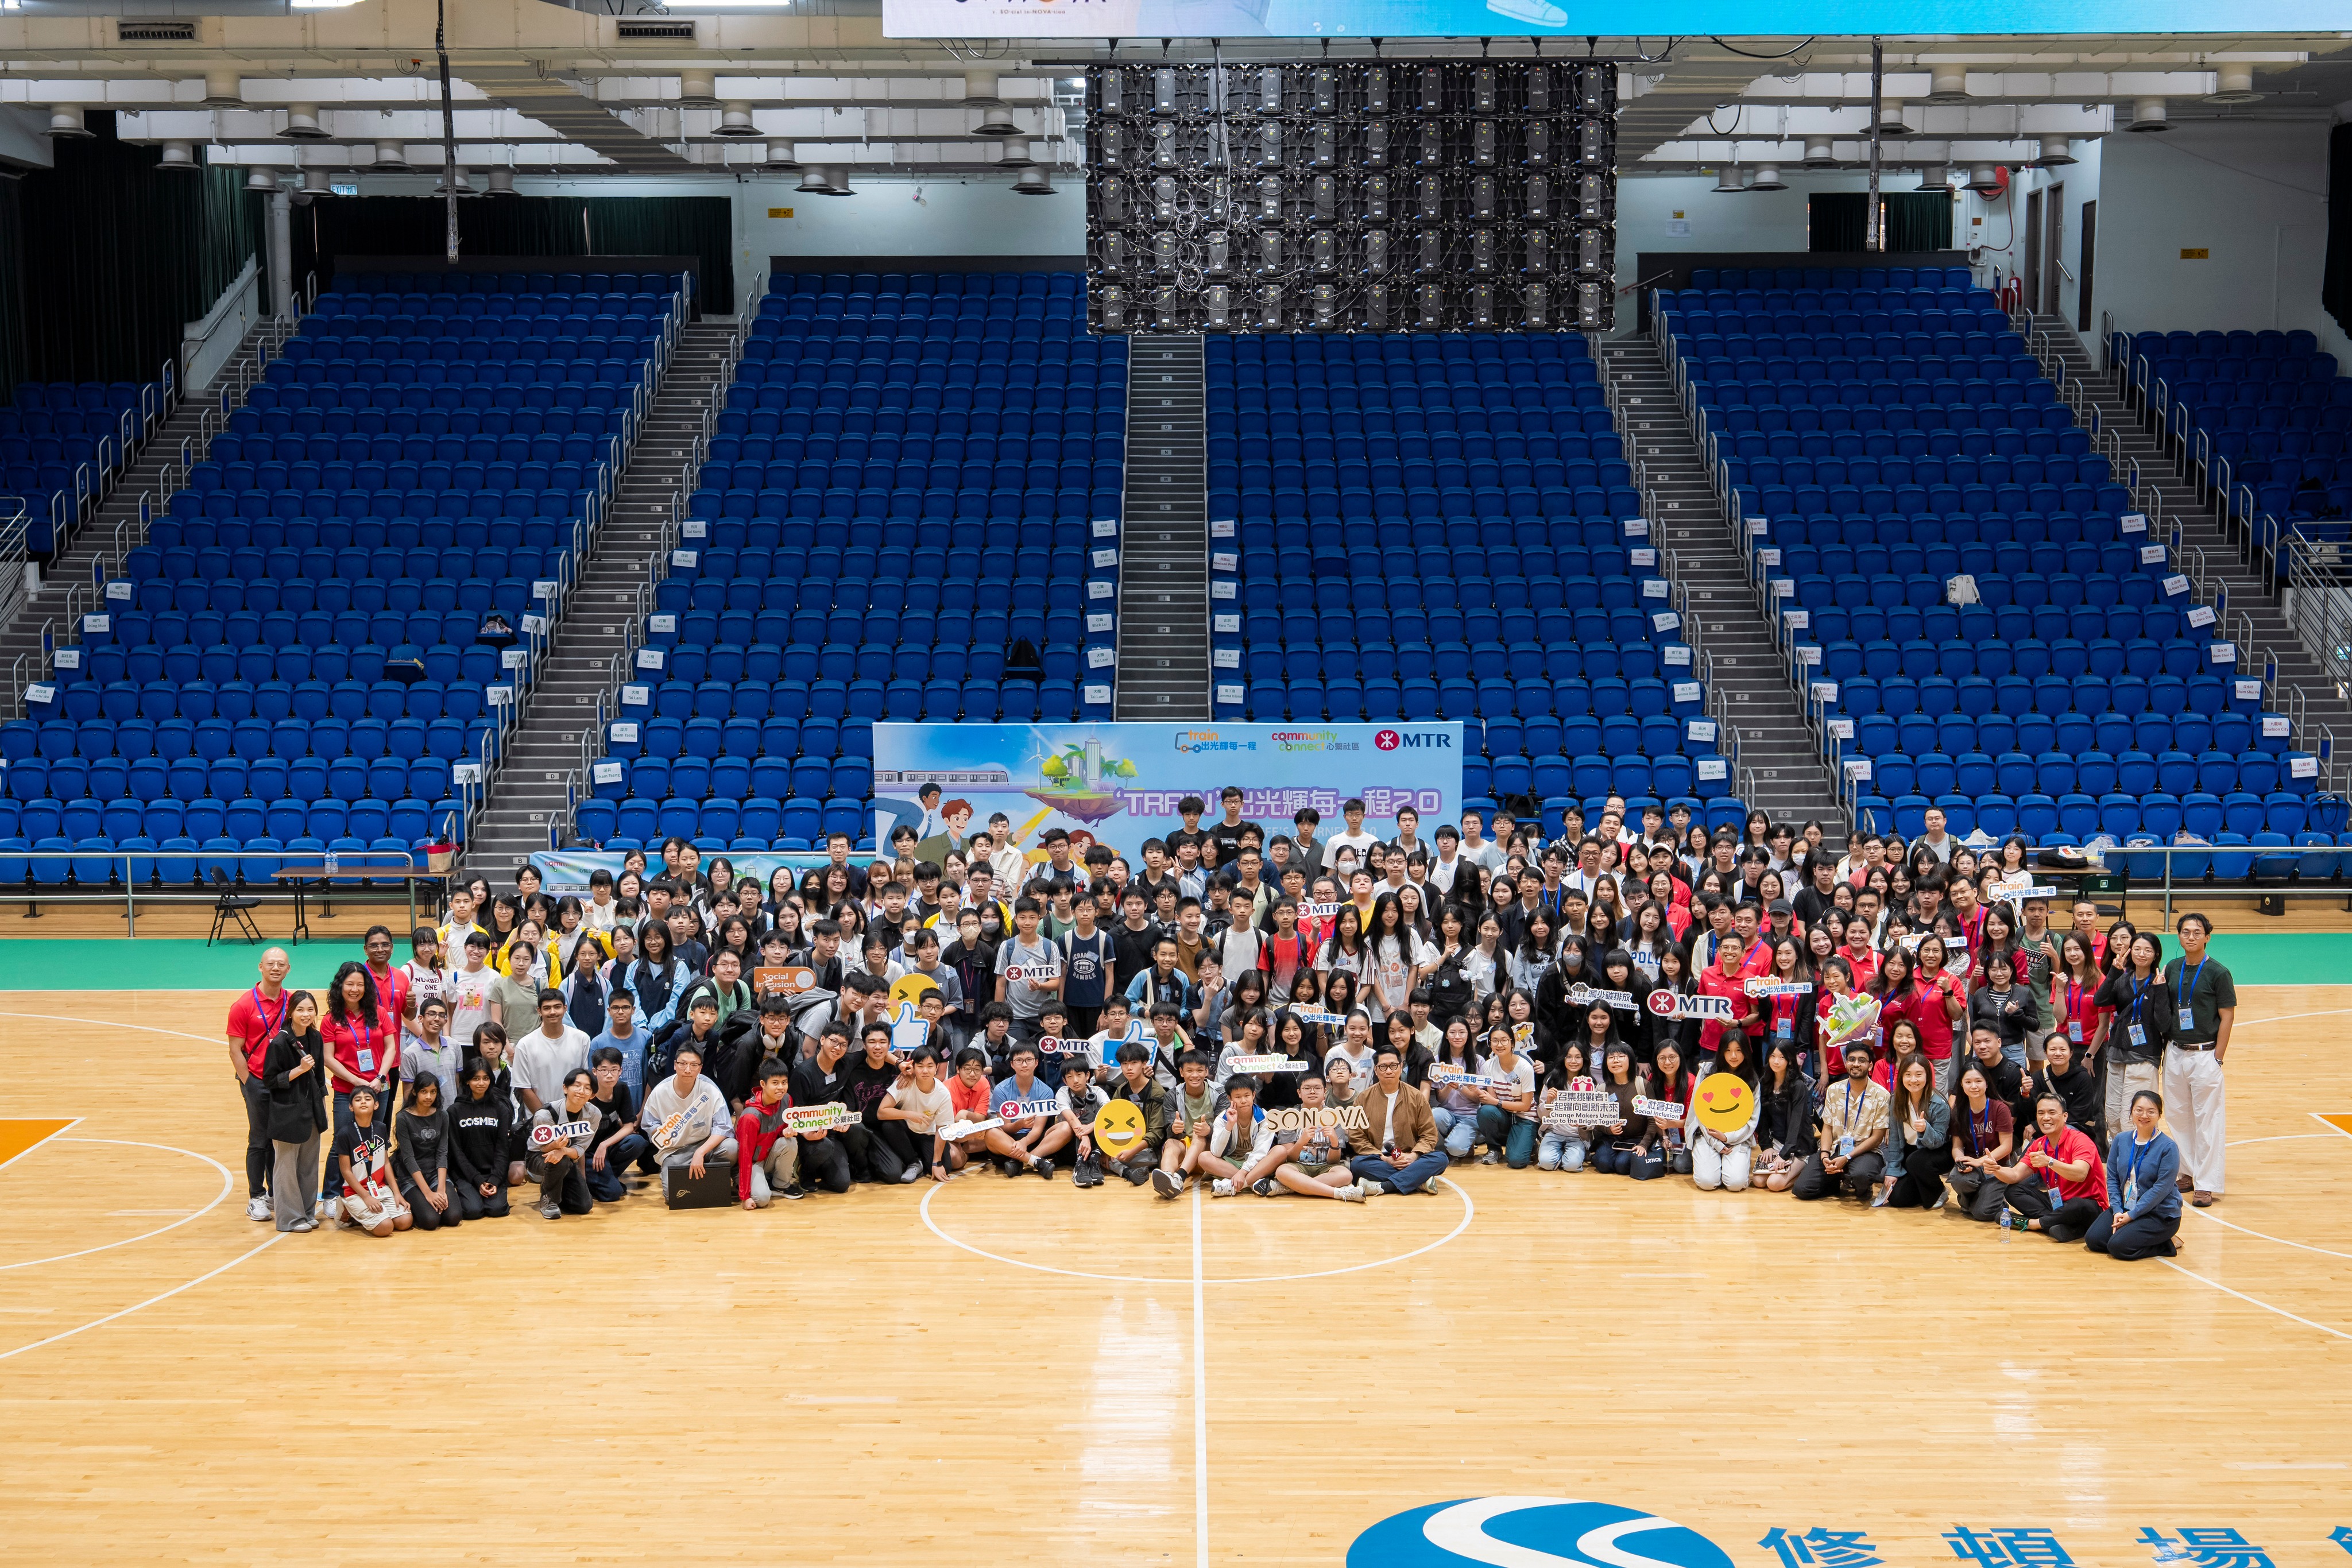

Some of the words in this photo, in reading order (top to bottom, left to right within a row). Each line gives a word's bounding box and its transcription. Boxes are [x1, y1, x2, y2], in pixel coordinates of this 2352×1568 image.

[1189, 729, 1218, 741] train
[1271, 730, 1337, 743] community
[1403, 733, 1452, 748] MTR
[1201, 741, 1257, 751] 出光輝每一程
[1279, 741, 1325, 752] connect
[1999, 882, 2024, 891] train
[2010, 888, 2054, 897] 出光輝每一程
[1312, 904, 1341, 914] MTR
[1024, 967, 1055, 977] MTR
[1756, 977, 1780, 986] train
[1766, 985, 1811, 993] 出光輝每一程
[1588, 989, 1631, 1002] 減少碳排放
[1299, 1004, 1323, 1014] train
[1679, 997, 1731, 1014] MTR
[1058, 1040, 1091, 1051] MTR
[1228, 1054, 1286, 1064] community
[1235, 1063, 1275, 1071] connect
[1440, 1063, 1464, 1074] train
[1449, 1074, 1491, 1085] 出光輝每一程
[1022, 1101, 1058, 1114] MTR
[1545, 1102, 1618, 1112] 一起躍向創新未來
[1647, 1100, 1682, 1113] 社會共融
[673, 1095, 709, 1133] 出光輝每一程
[786, 1106, 843, 1120] community
[1653, 1110, 1679, 1119] inclusion
[459, 1117, 498, 1128] COSMEX
[659, 1113, 682, 1135] train
[792, 1118, 833, 1129] connect
[833, 1114, 860, 1124] 心繫社區
[1267, 1108, 1368, 1130] SONOVA
[554, 1121, 590, 1140] MTR
